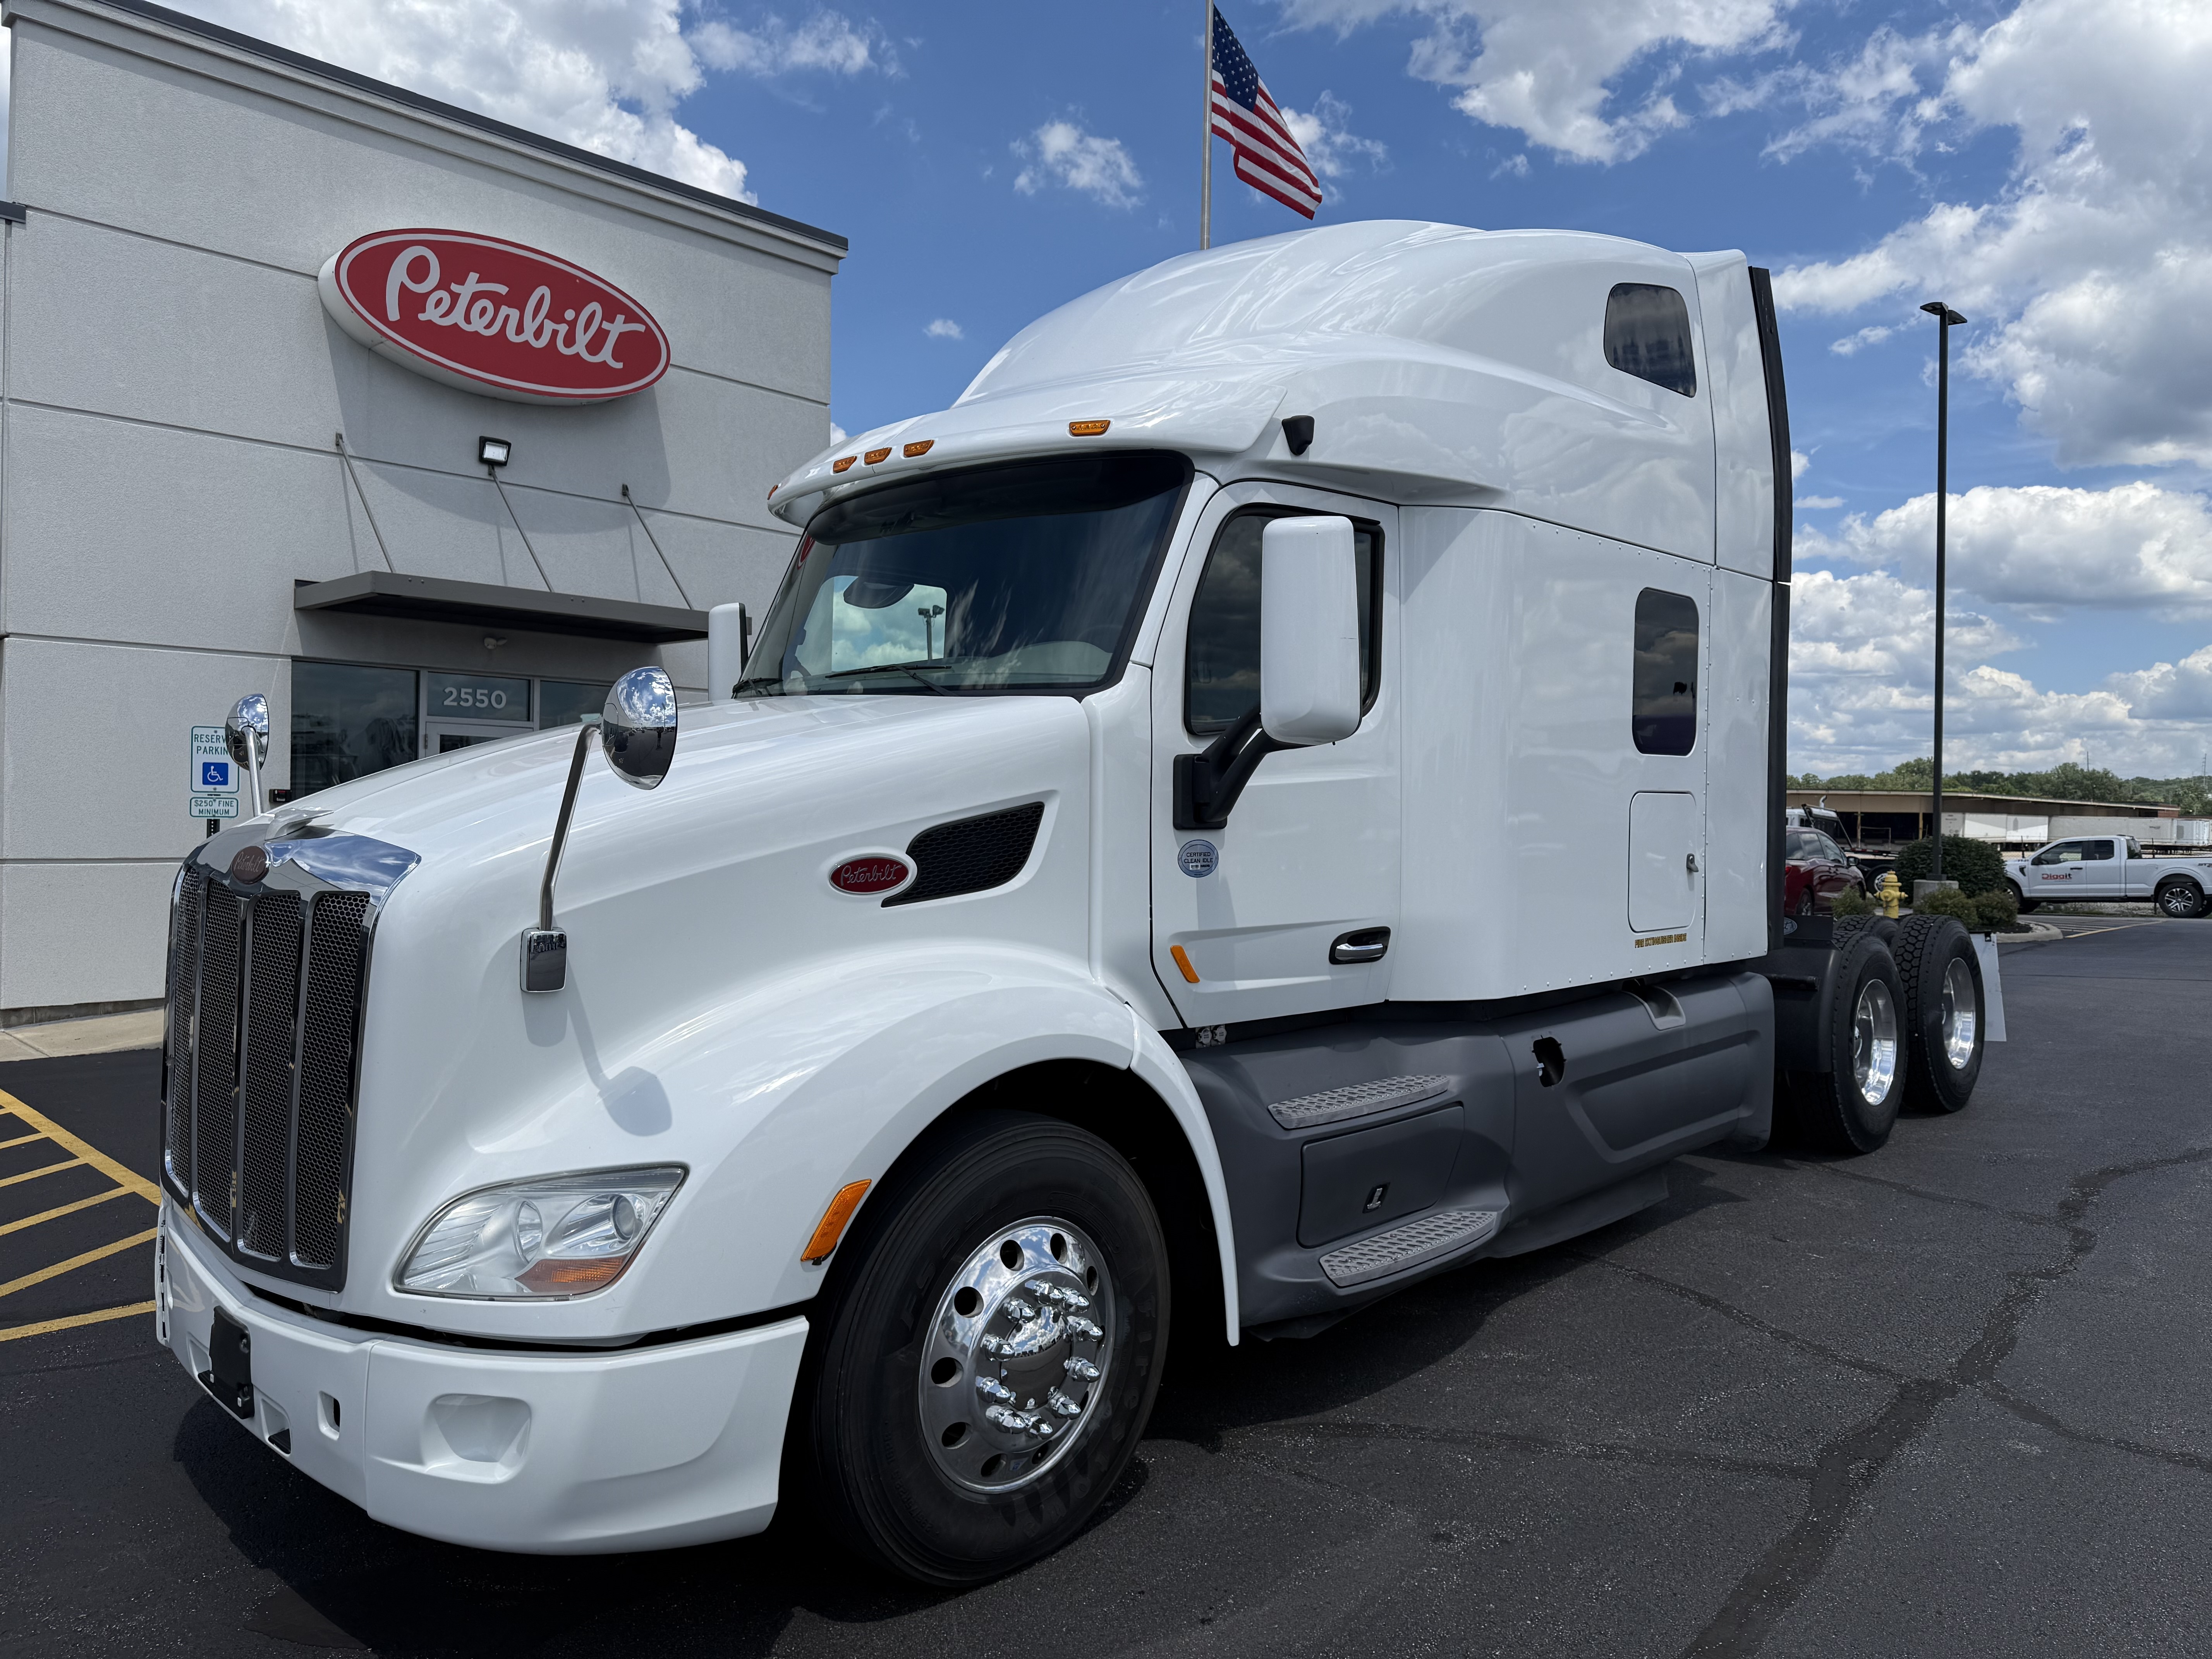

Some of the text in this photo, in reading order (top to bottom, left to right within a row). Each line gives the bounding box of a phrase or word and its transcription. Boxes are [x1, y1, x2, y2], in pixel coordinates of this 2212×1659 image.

[386, 246, 646, 369] Peterbilt
[443, 687, 507, 709] 2550
[194, 734, 225, 743] RESERV
[196, 746, 228, 755] PARKIN
[234, 852, 264, 872] Peterbilt
[840, 864, 902, 886] Peterbilt
[1635, 939, 1644, 948] FIRE
